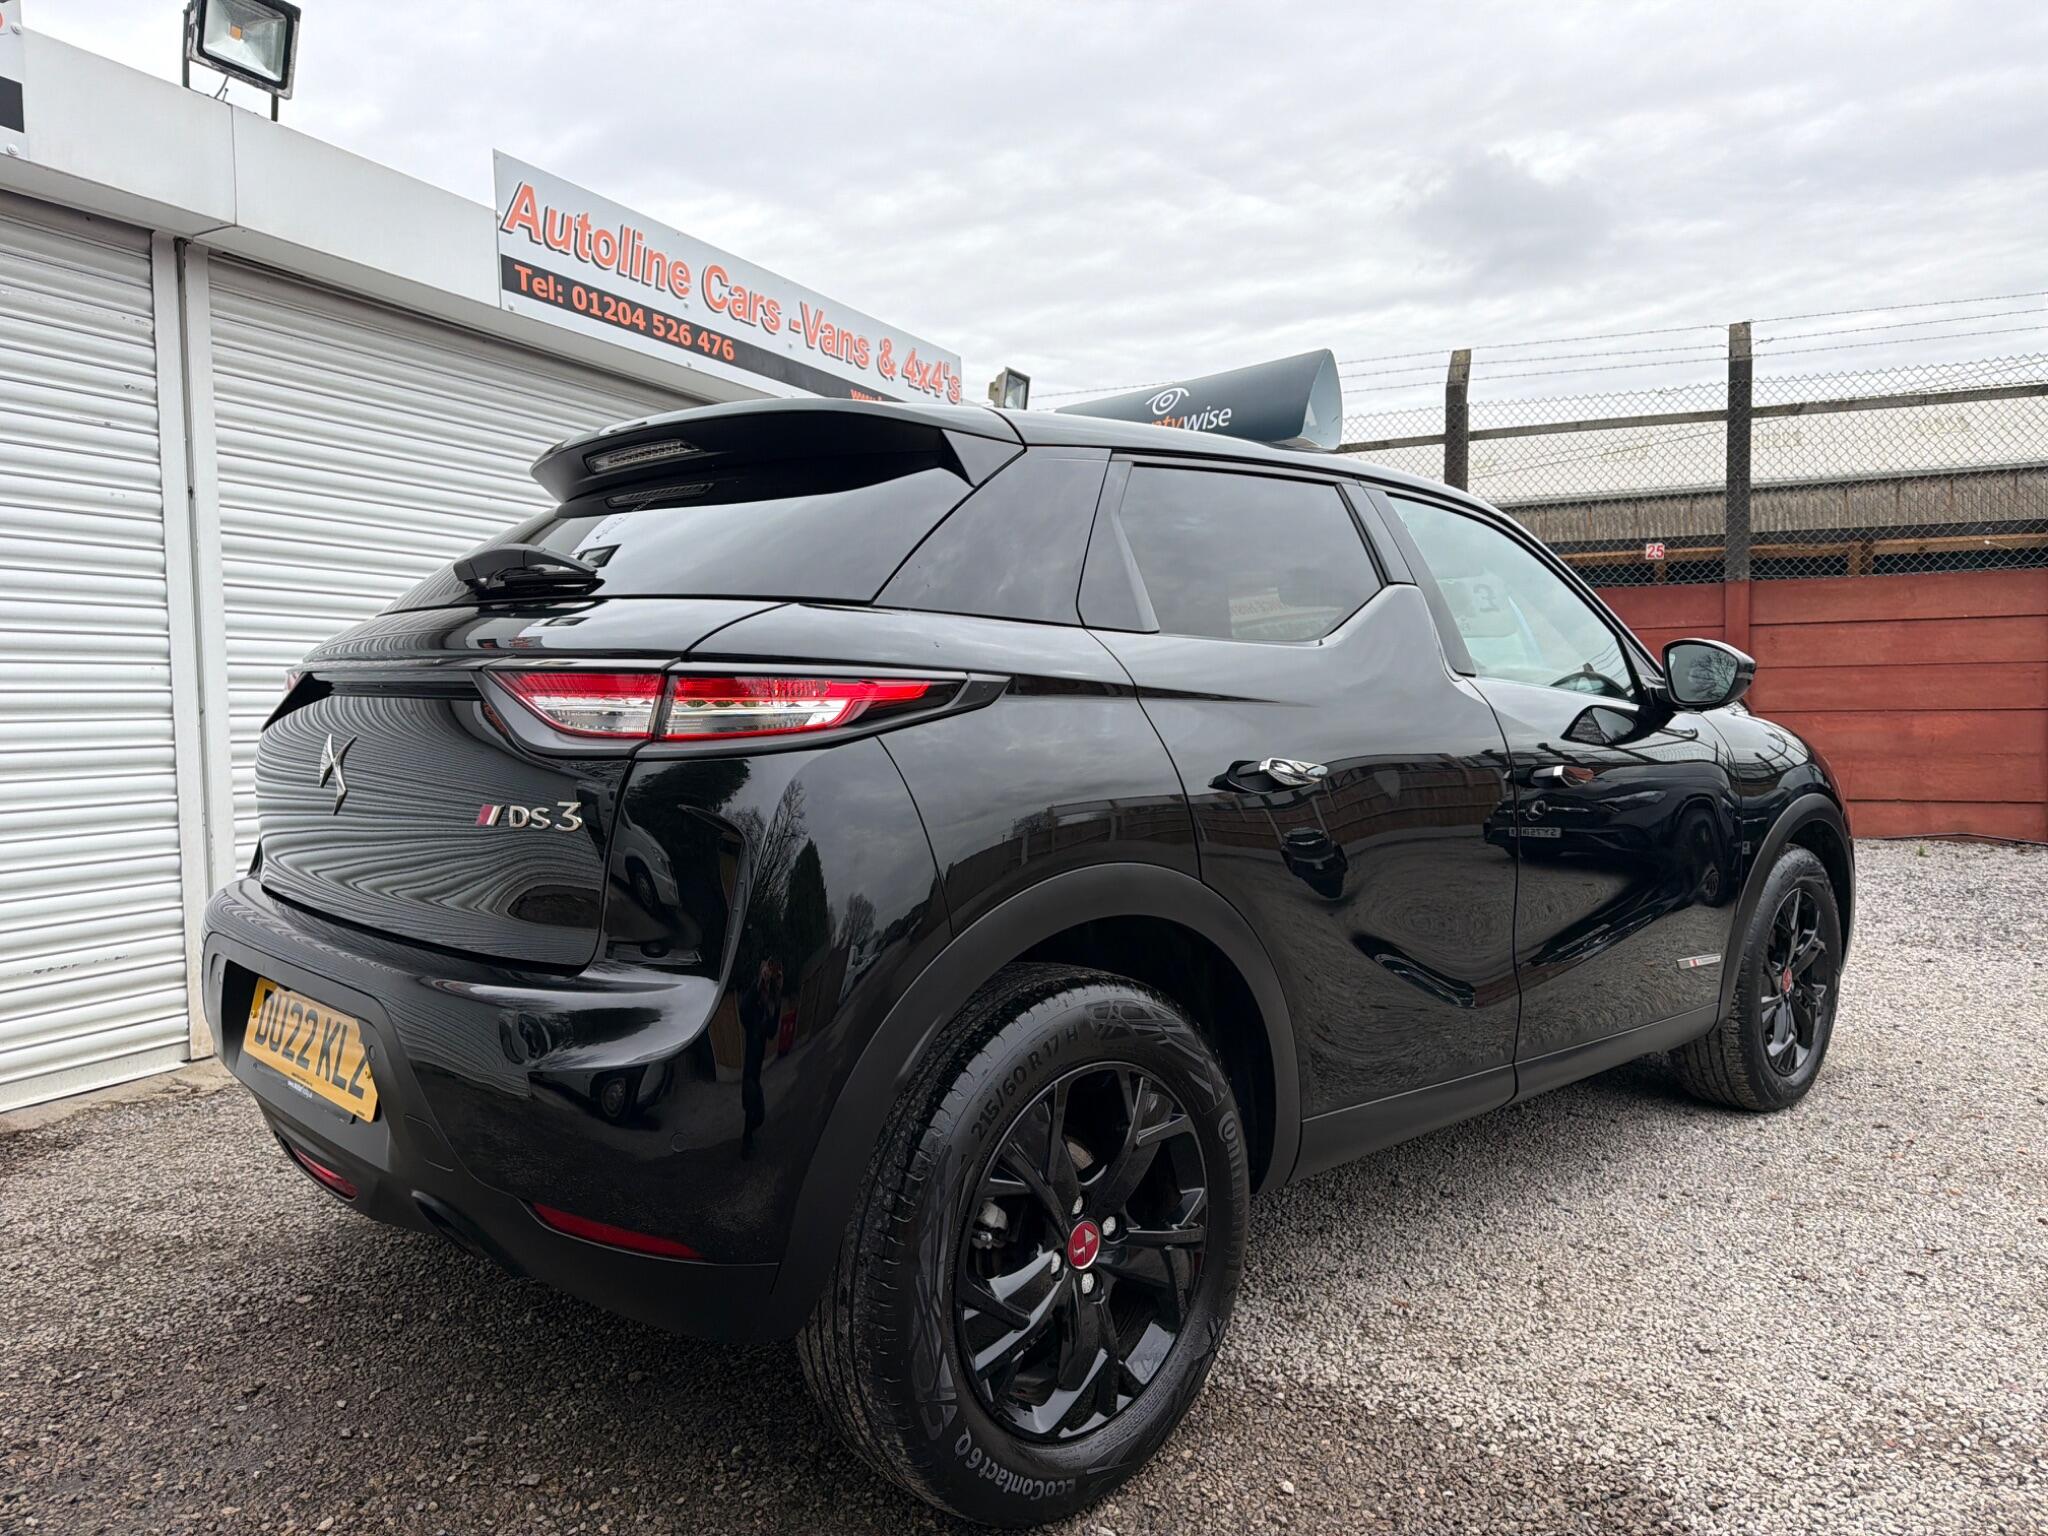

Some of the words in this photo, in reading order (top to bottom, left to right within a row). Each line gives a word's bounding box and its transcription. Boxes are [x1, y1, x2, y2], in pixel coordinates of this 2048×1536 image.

[500, 182, 691, 299] Autoline
[702, 264, 782, 334] Cars
[877, 337, 898, 381] &
[901, 347, 962, 405] 4x4's
[514, 264, 564, 304] Tel:
[571, 285, 646, 331] 01204
[652, 313, 692, 346] 526
[697, 330, 736, 361] 476
[1647, 545, 1664, 558] 25
[971, 1066, 1028, 1140] 215/60
[1027, 1050, 1042, 1071] R
[1043, 1034, 1059, 1057] 17
